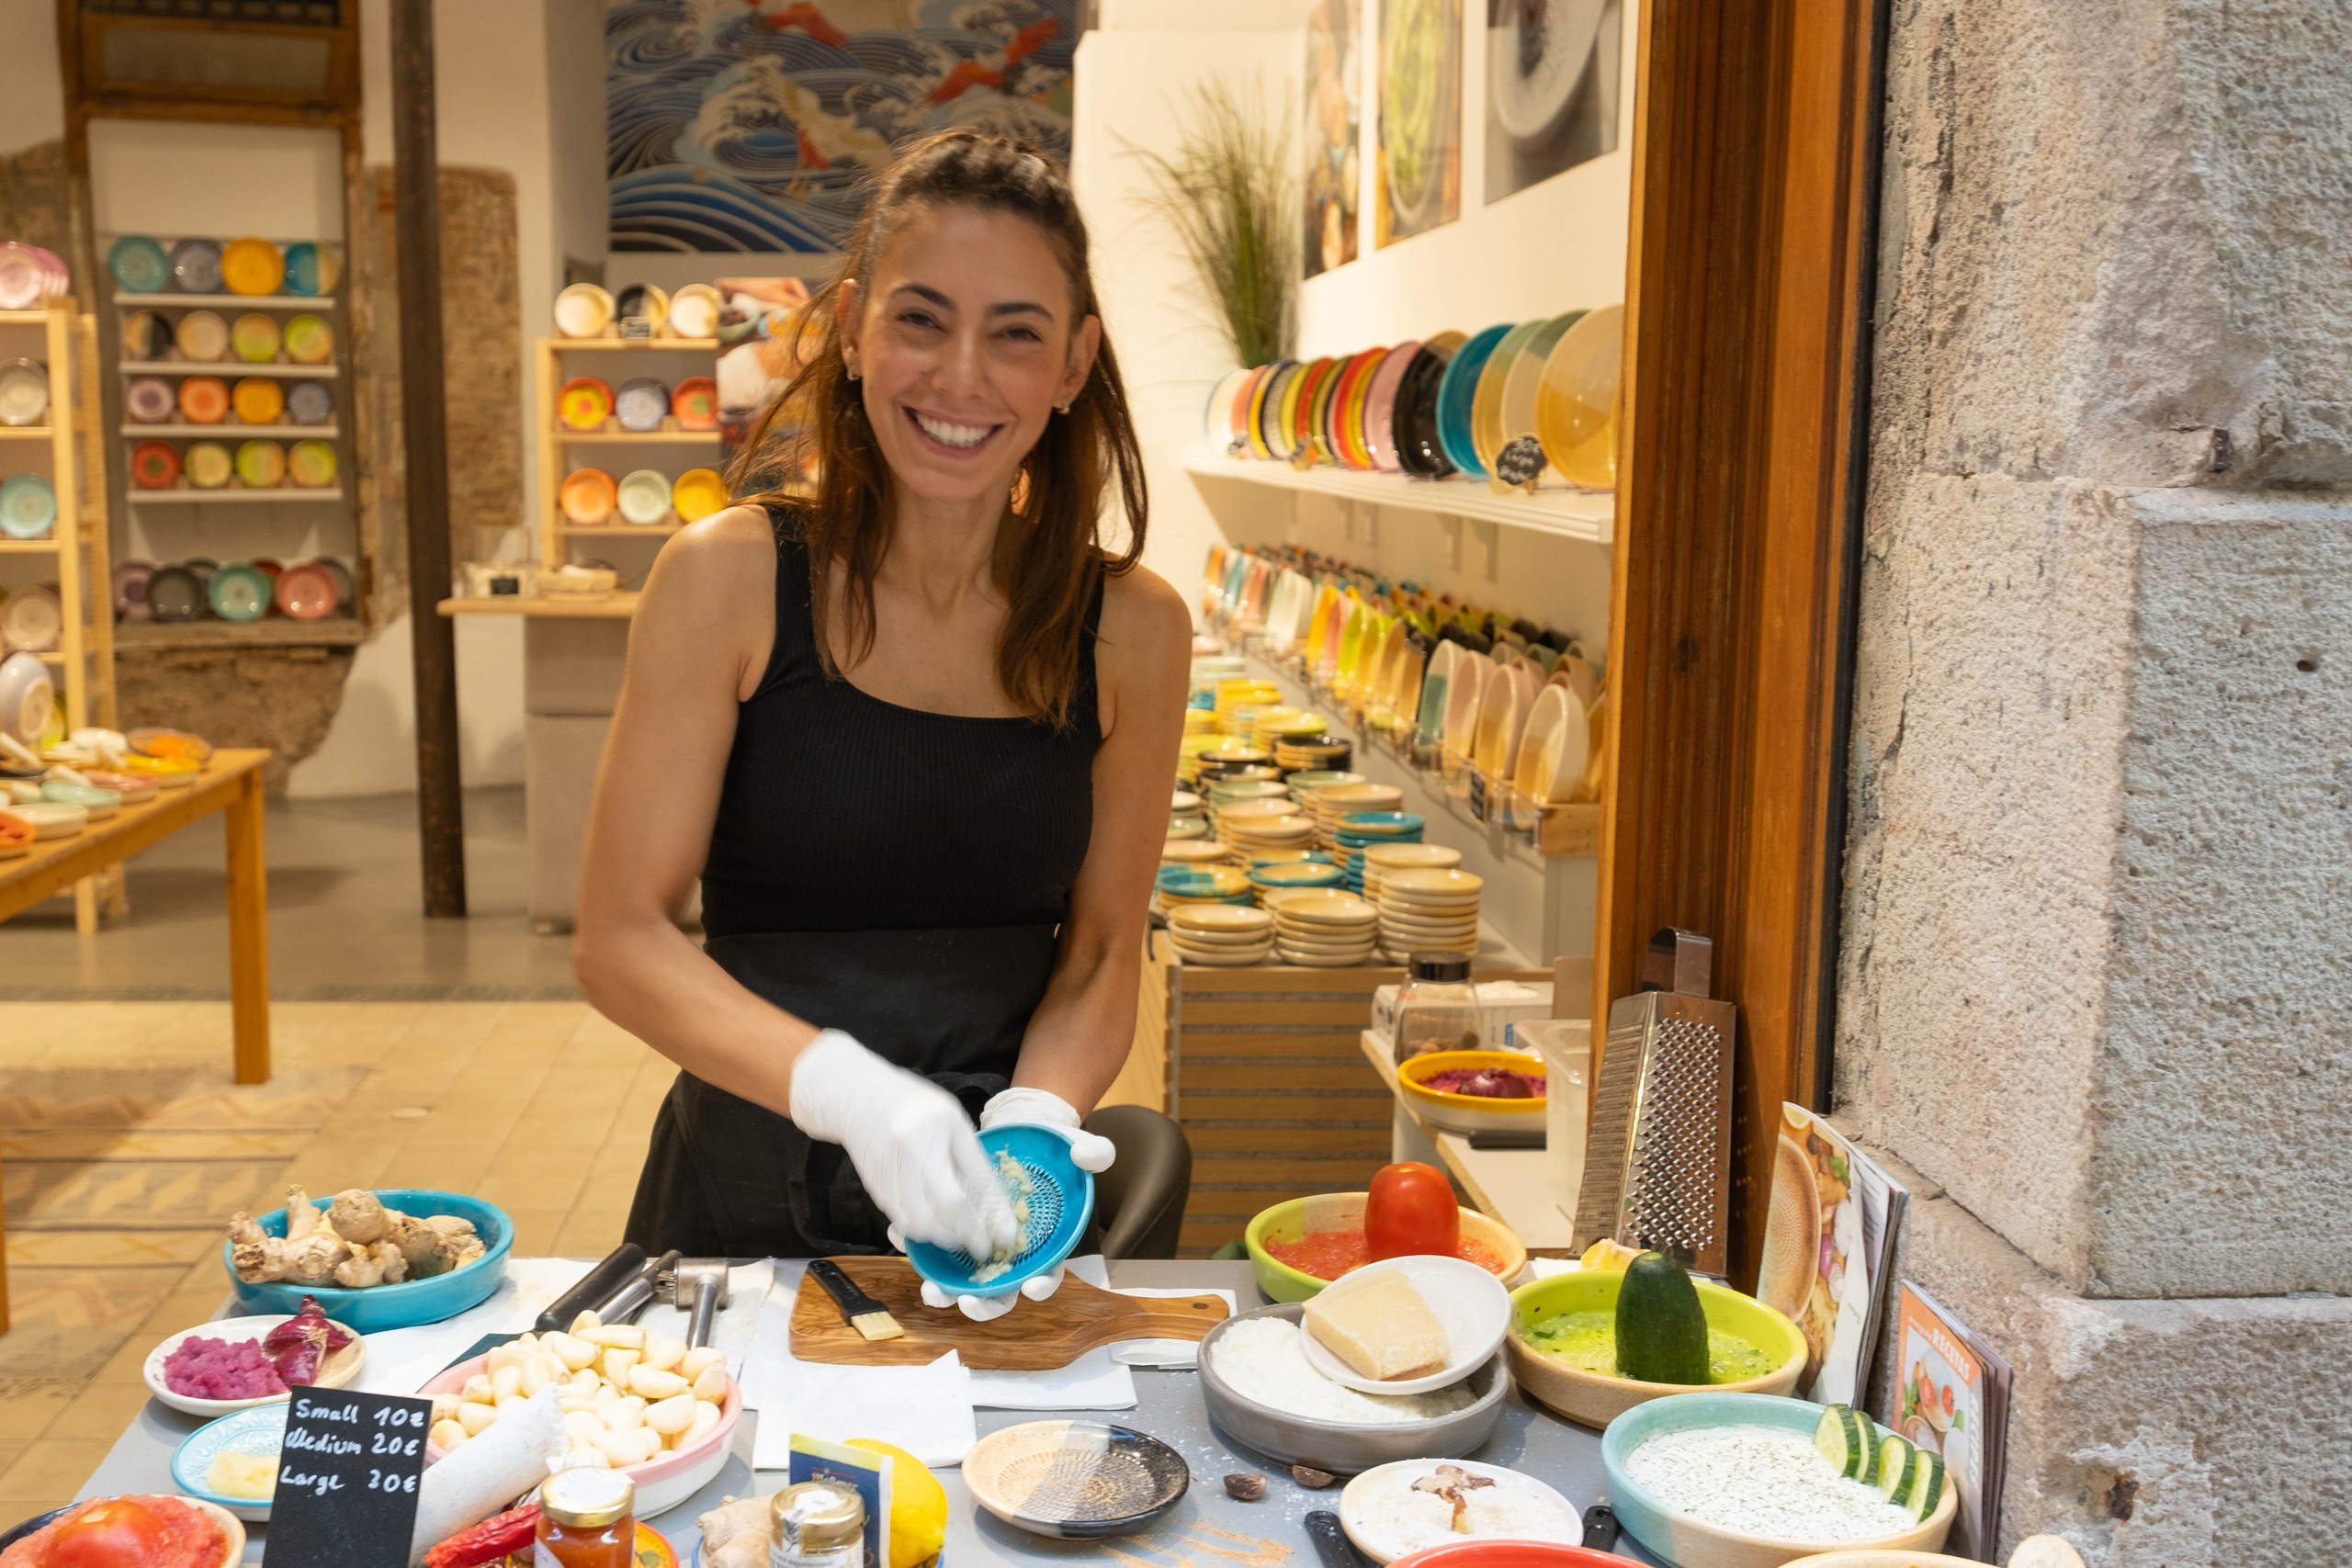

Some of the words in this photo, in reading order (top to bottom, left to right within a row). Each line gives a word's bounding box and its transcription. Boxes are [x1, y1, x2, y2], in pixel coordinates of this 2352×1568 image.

[295, 1397, 359, 1424] Small
[372, 1406, 424, 1427] 10€
[370, 1432, 420, 1457] 20€
[279, 1465, 345, 1496] Large
[368, 1469, 417, 1493] 30€
